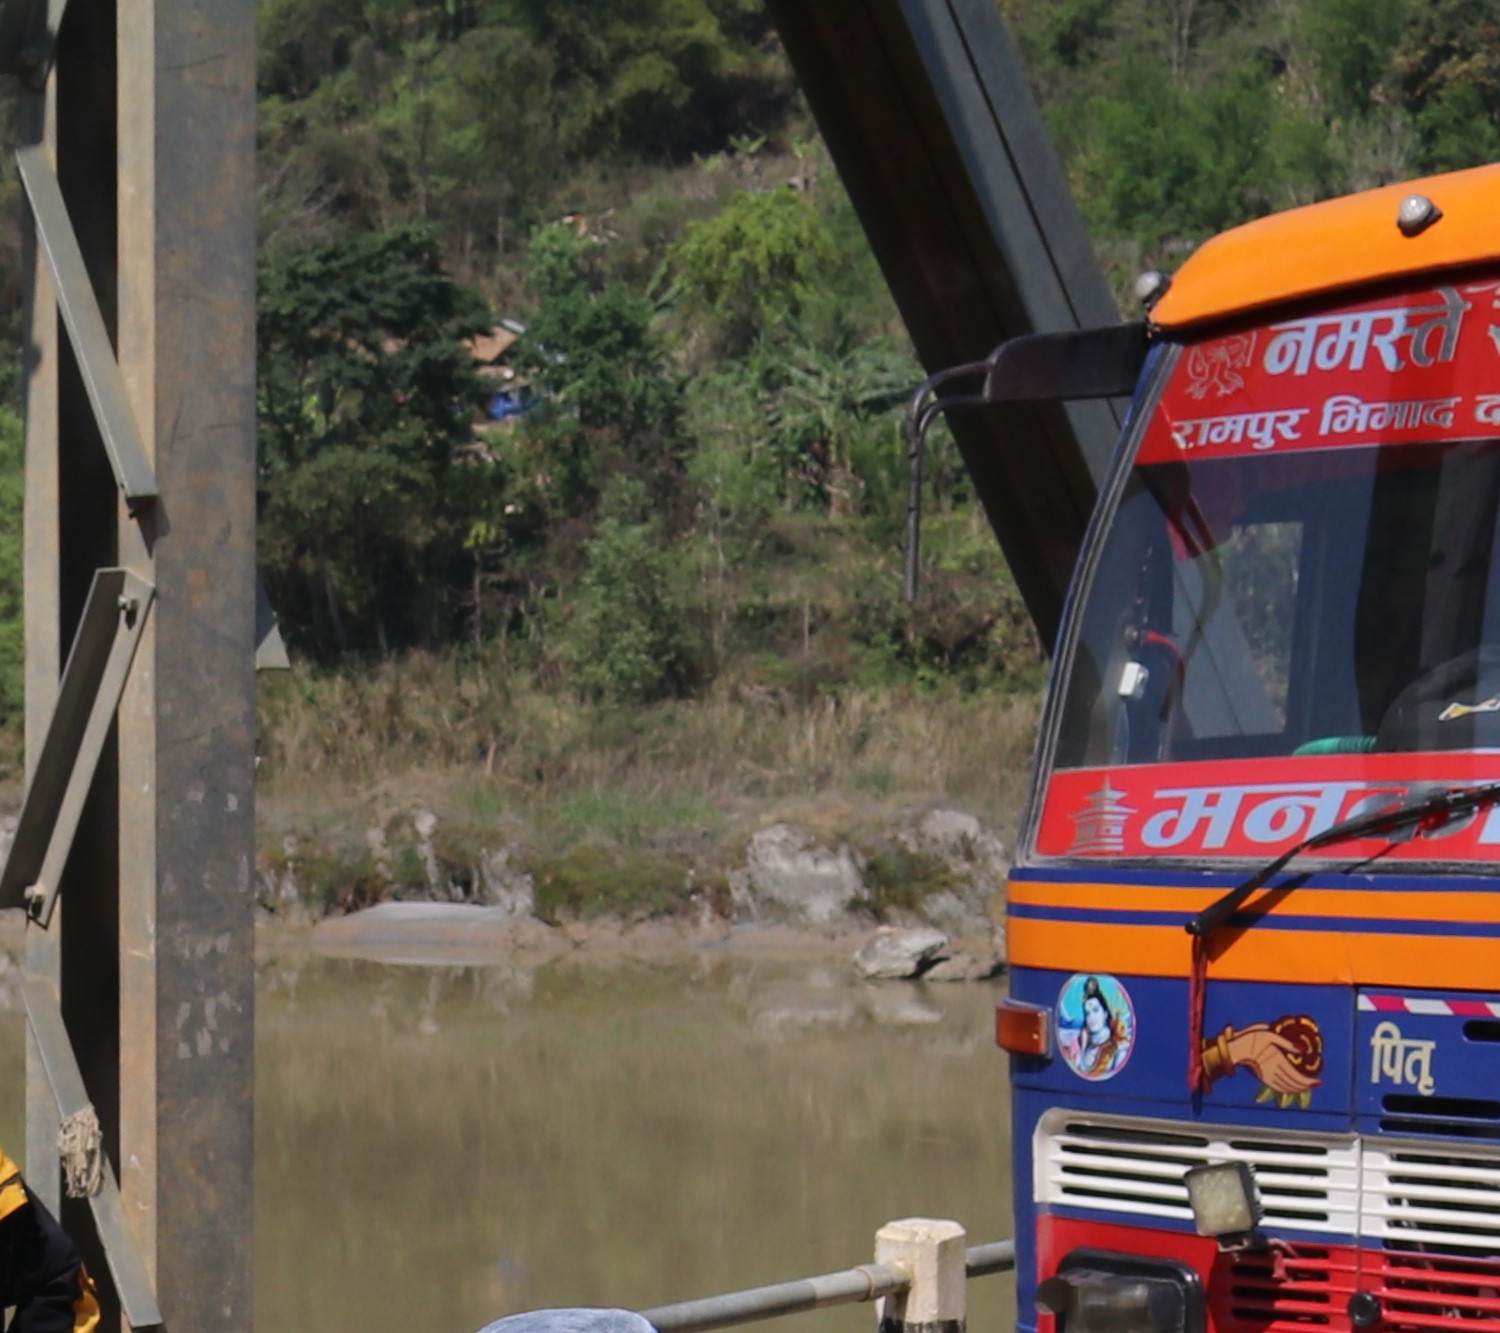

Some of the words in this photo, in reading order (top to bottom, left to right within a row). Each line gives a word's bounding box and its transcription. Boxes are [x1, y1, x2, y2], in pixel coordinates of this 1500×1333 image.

[1264, 284, 1472, 376] नमस्ते
[1171, 407, 1310, 451] रामपुर
[1370, 1020, 1437, 1096] पितृ
